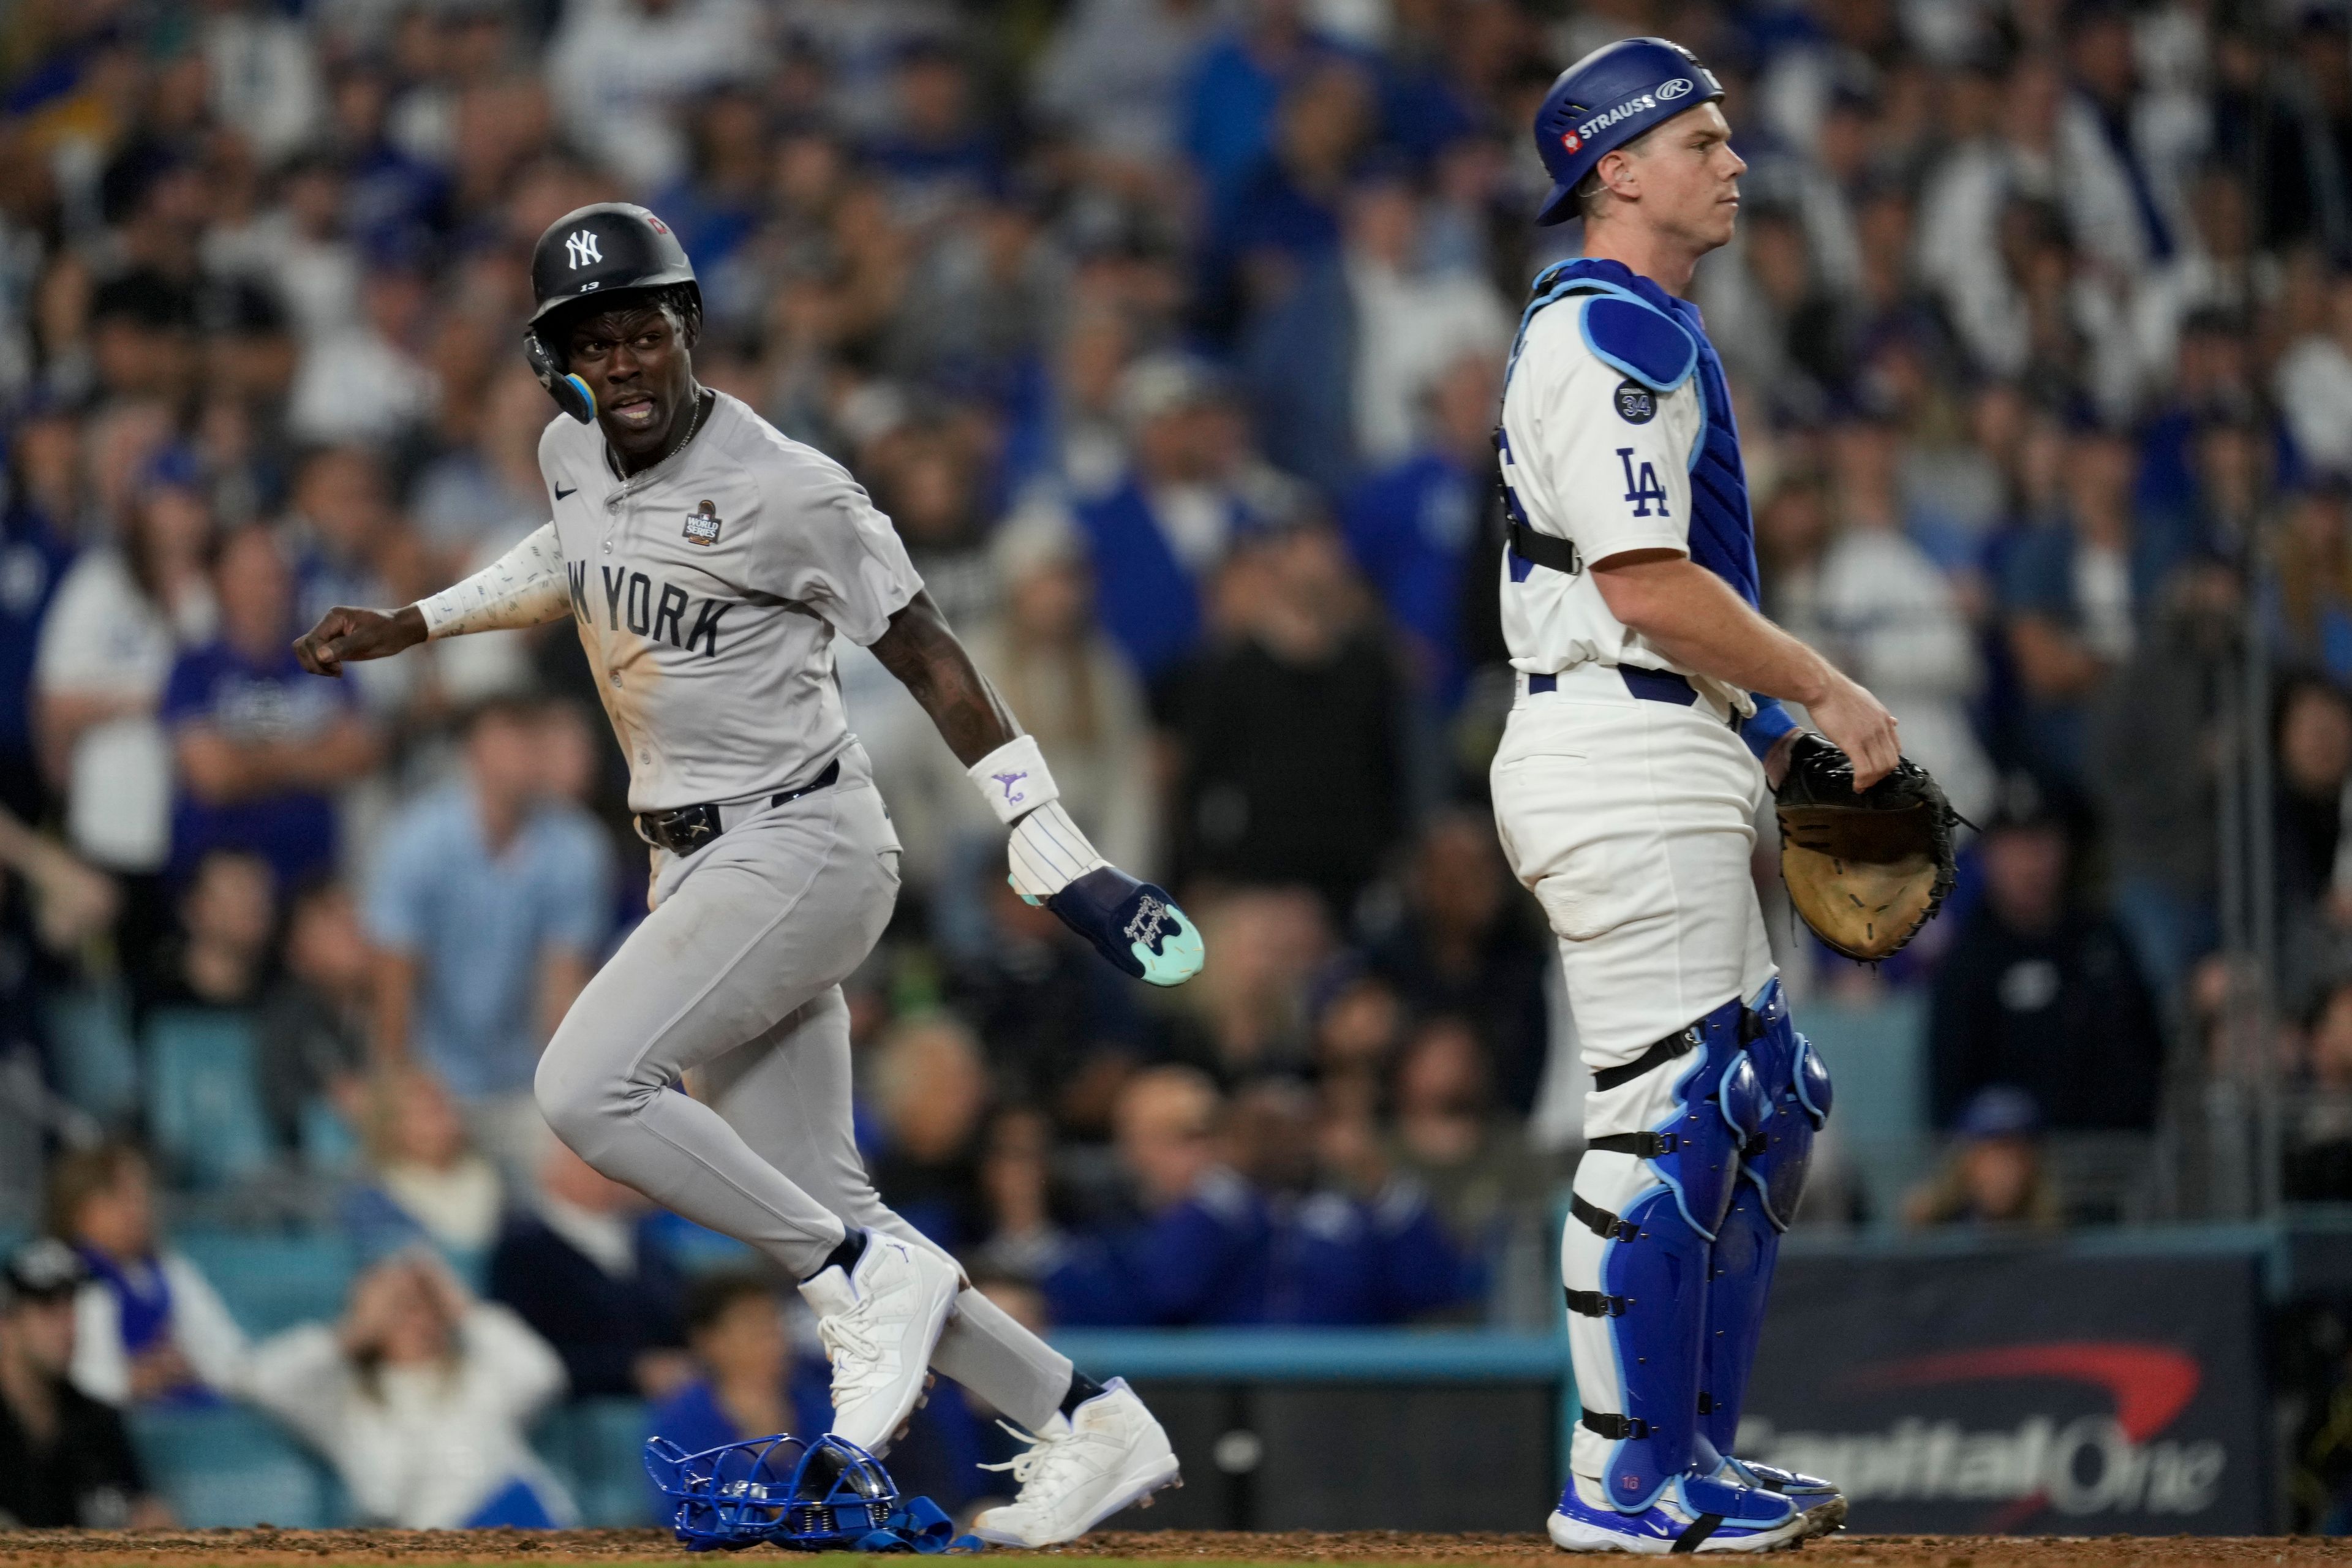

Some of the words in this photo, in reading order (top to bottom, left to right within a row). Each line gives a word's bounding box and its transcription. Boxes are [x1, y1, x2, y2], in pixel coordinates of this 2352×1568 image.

[1578, 94, 1656, 139] STRAUSS
[565, 230, 603, 270] NY
[580, 282, 599, 292] 13
[1622, 395, 1651, 416] 34
[1616, 447, 1671, 517] LA
[686, 525, 716, 538] SERIES
[687, 516, 719, 530] WORLD
[601, 566, 736, 657] YORK
